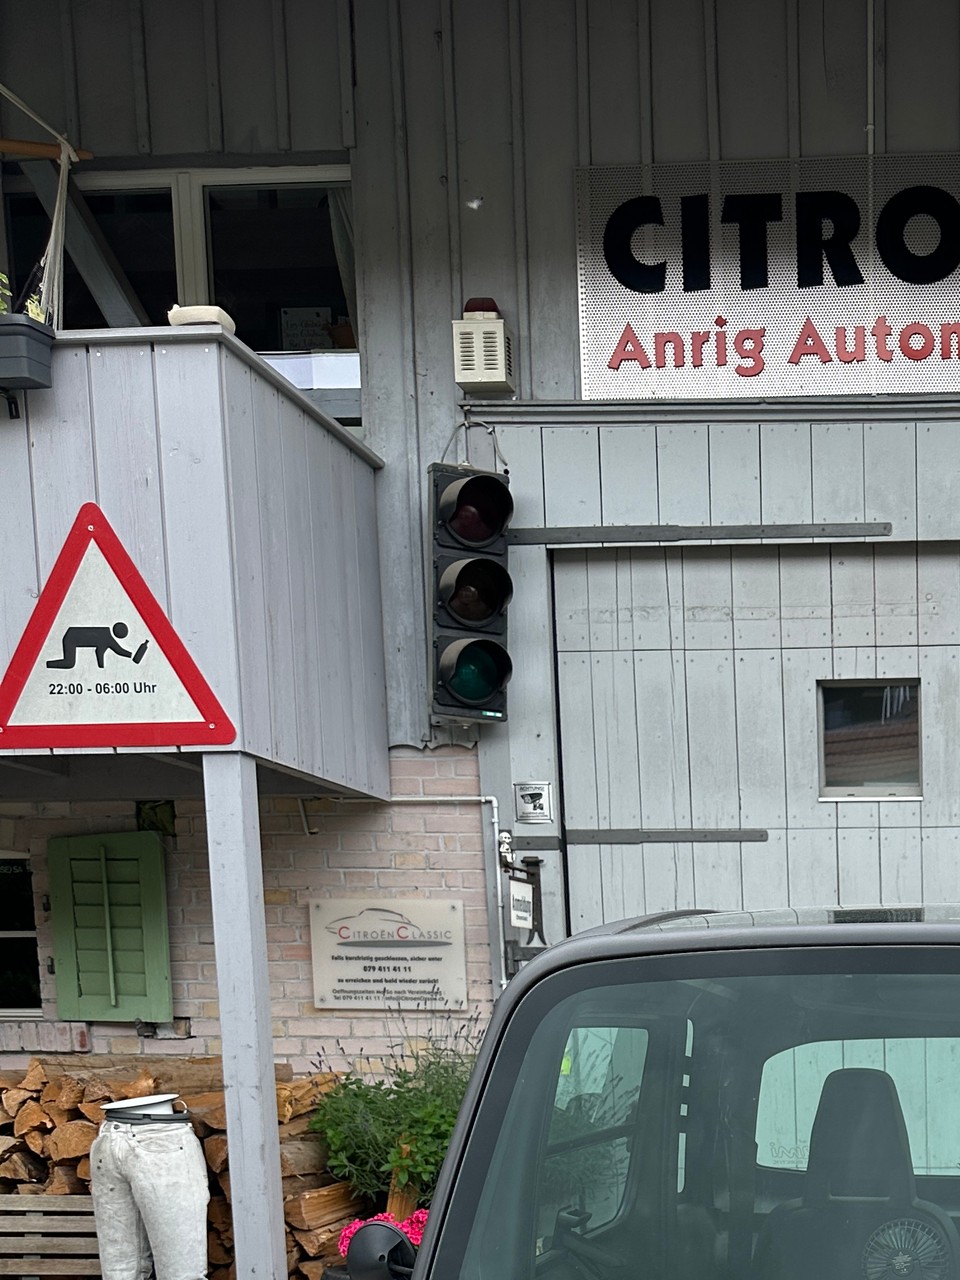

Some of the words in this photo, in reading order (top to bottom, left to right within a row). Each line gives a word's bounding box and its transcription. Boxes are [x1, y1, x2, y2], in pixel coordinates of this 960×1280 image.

[607, 315, 767, 378] Anrig
[49, 683, 83, 695] 22:00
[95, 682, 130, 694] 06:00
[133, 682, 157, 694] Uhr
